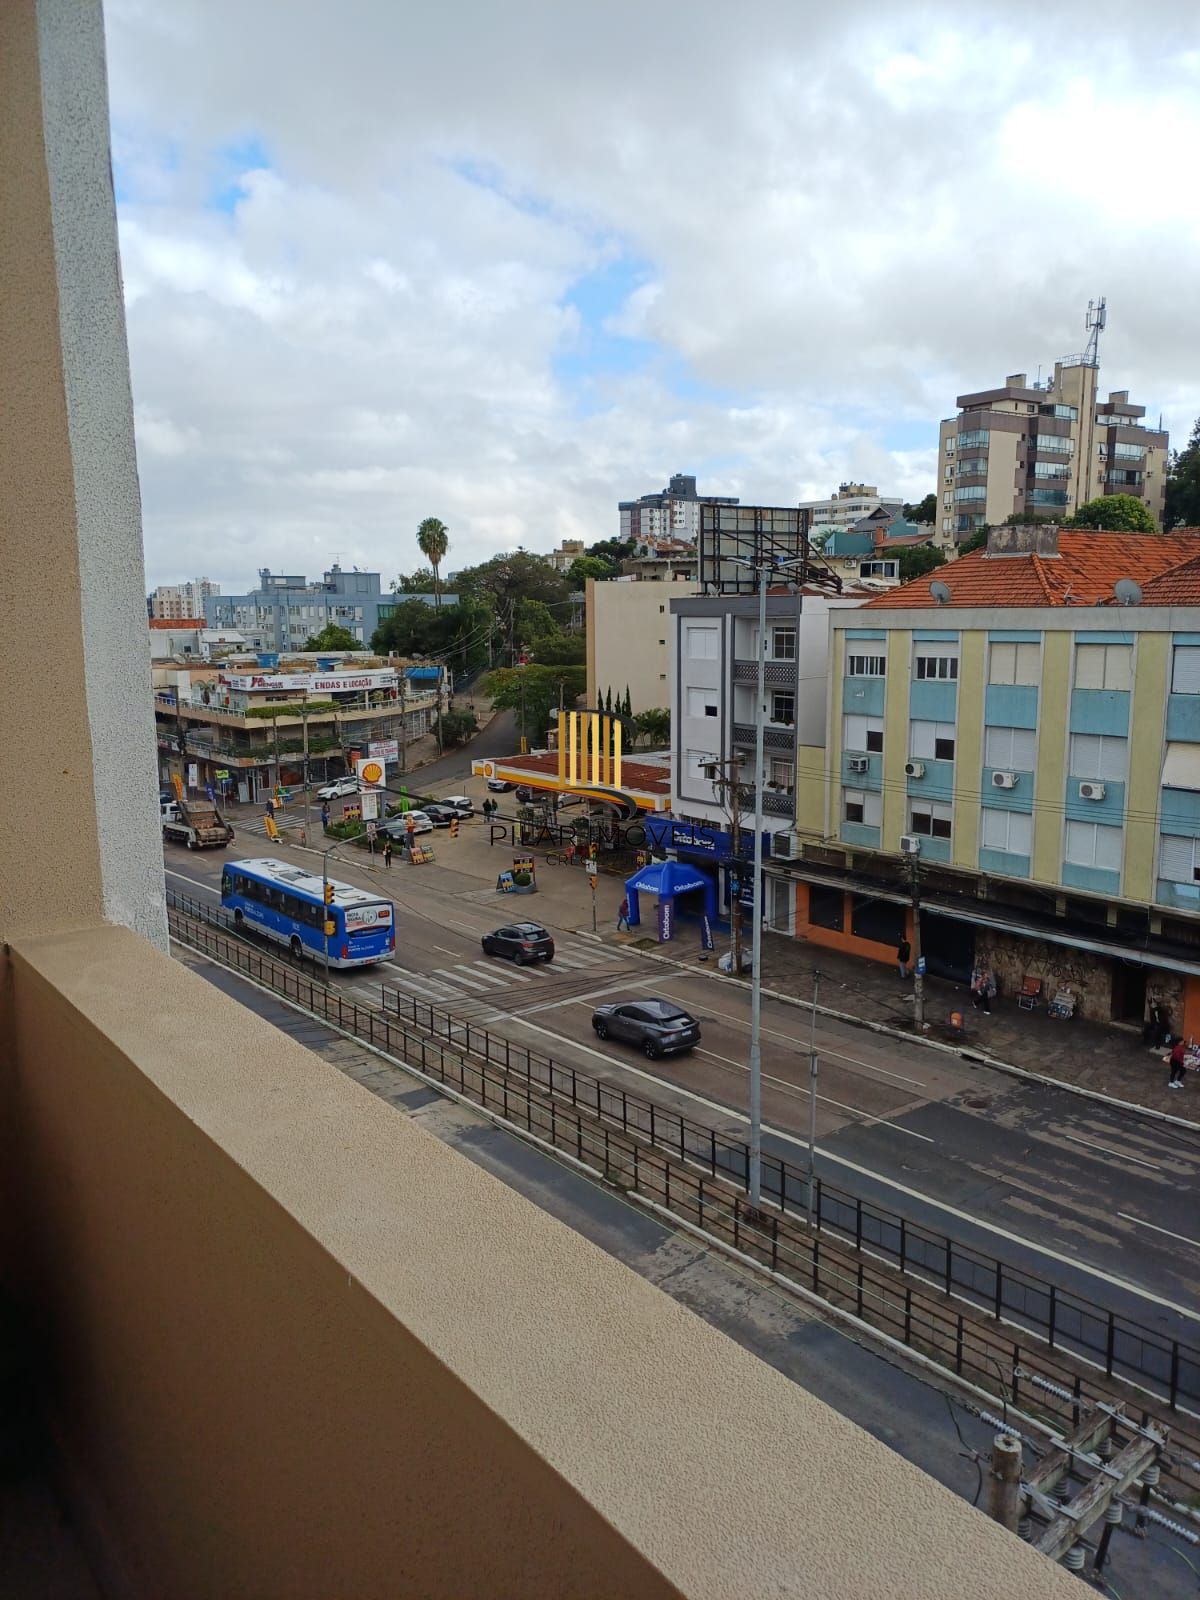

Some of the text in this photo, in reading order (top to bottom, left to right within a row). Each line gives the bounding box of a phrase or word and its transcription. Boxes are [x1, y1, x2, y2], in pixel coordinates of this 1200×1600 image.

[314, 681, 341, 690] ENDAS
[635, 881, 660, 893] Ortobom
[673, 880, 705, 892] Ortobom
[662, 904, 670, 940] Ortobom
